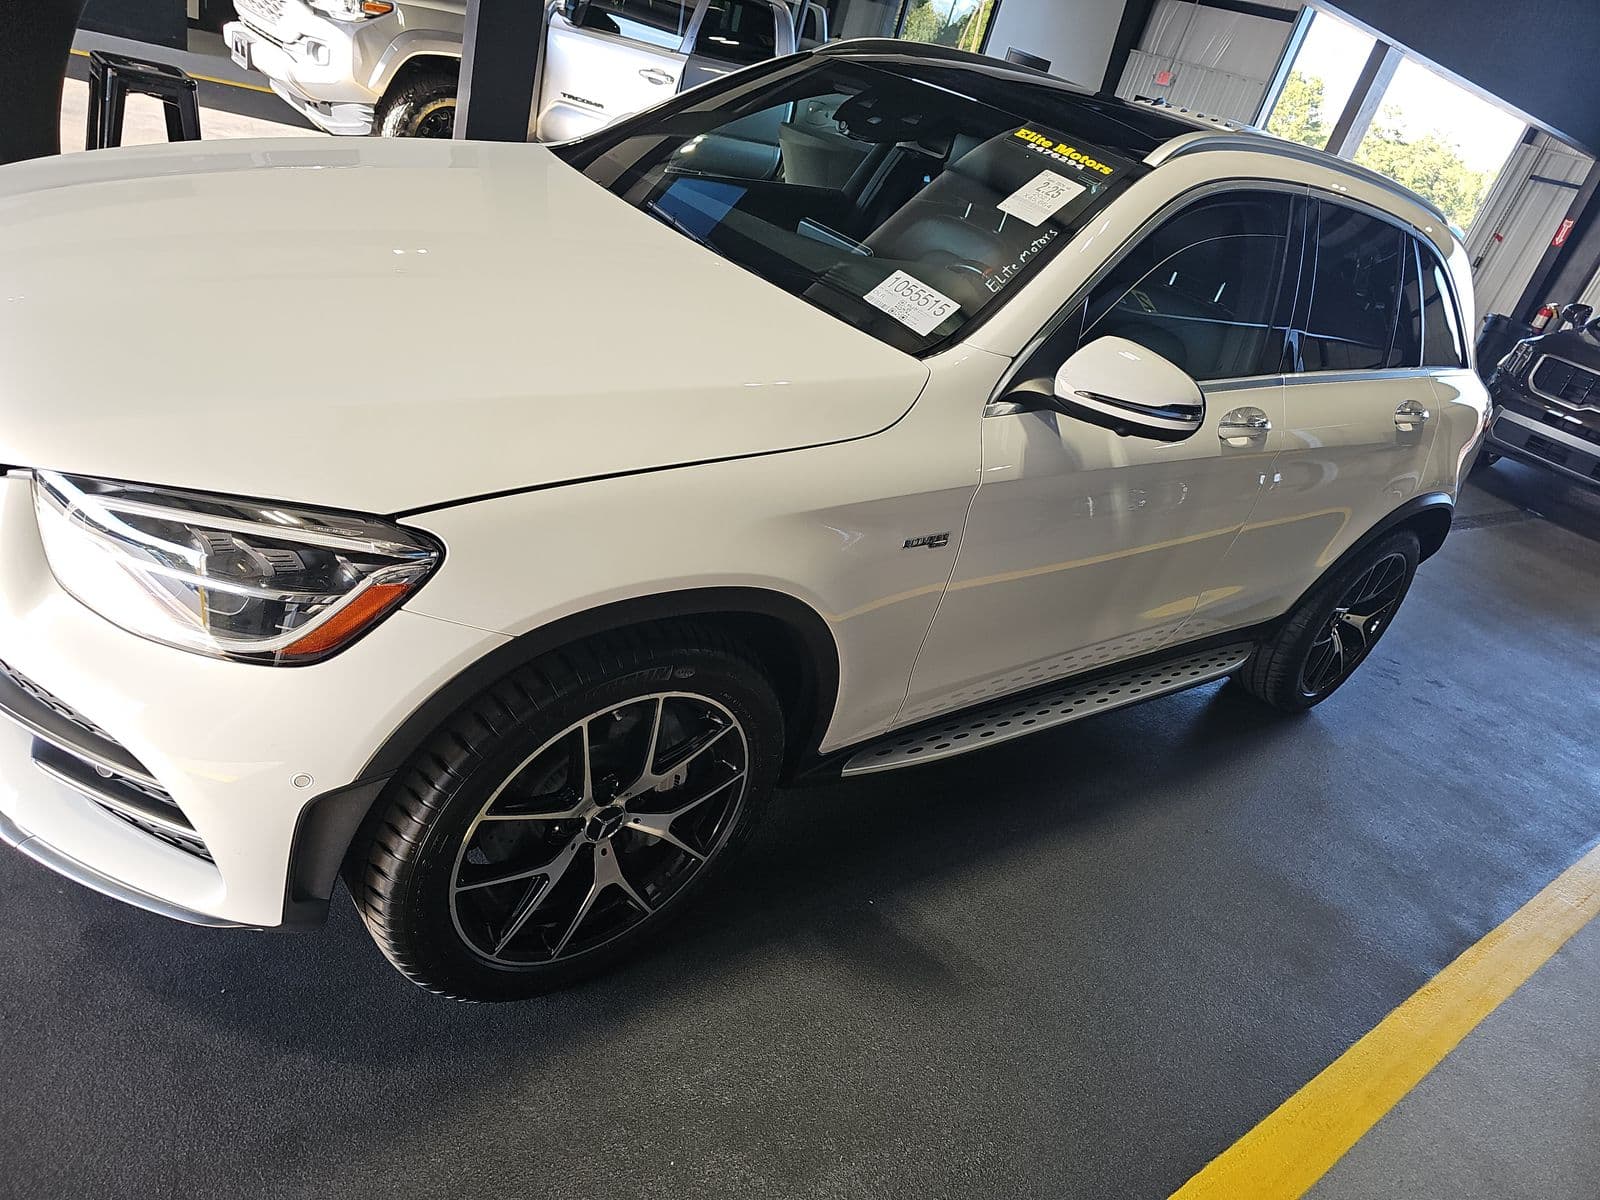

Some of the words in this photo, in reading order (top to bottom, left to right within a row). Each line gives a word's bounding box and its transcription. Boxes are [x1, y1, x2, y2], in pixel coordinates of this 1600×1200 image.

[560, 91, 604, 109] TACOMA
[1014, 128, 1053, 148] Elite
[1053, 143, 1113, 175] Motors
[888, 276, 951, 317] 1055515
